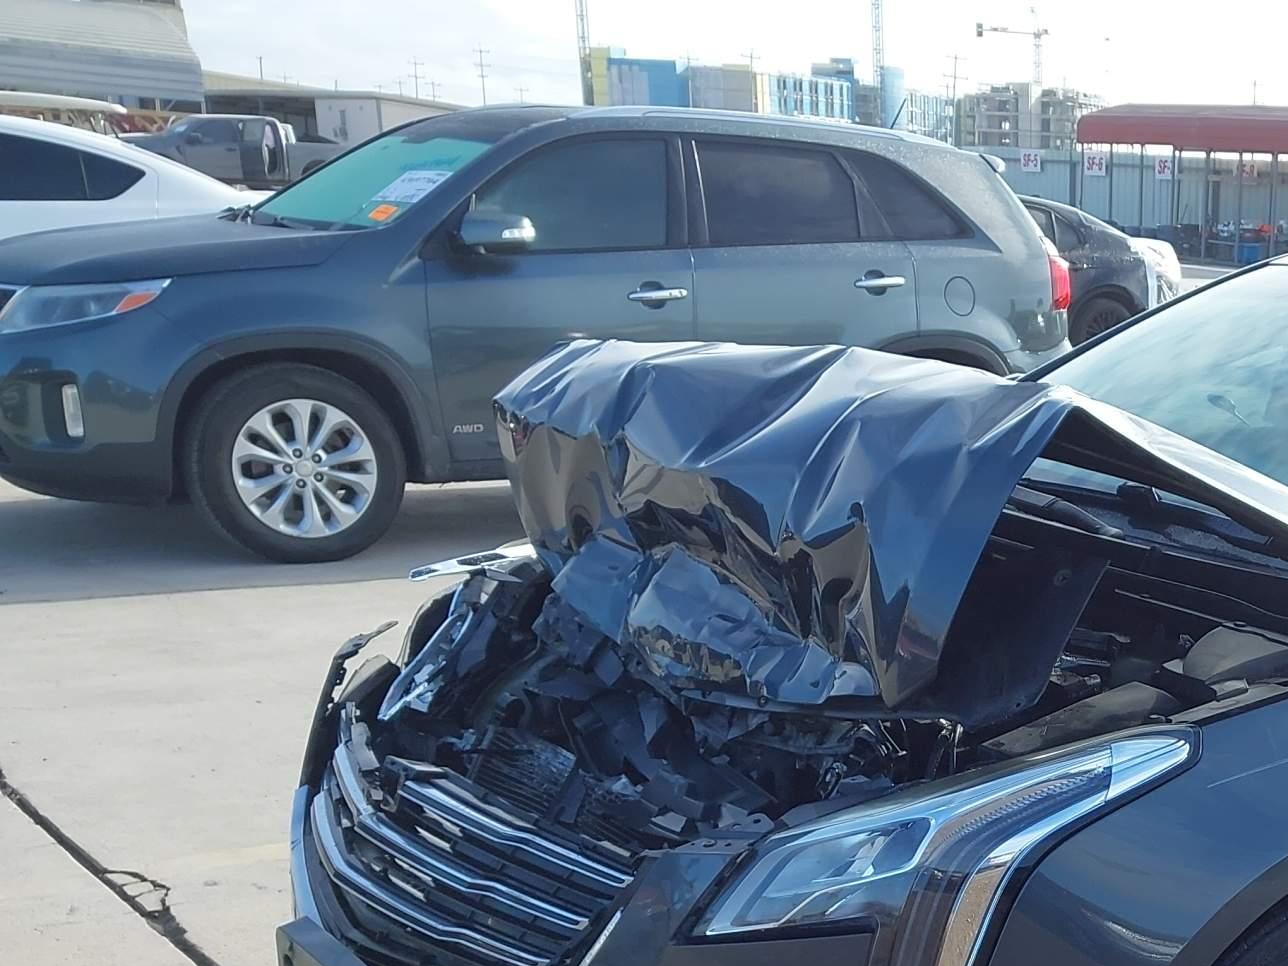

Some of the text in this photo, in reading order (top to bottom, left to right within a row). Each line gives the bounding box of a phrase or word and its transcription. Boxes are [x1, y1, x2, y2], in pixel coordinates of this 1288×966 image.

[1022, 153, 1038, 168] SF-5
[1086, 156, 1103, 171] SF-6
[452, 423, 484, 434] AWD
